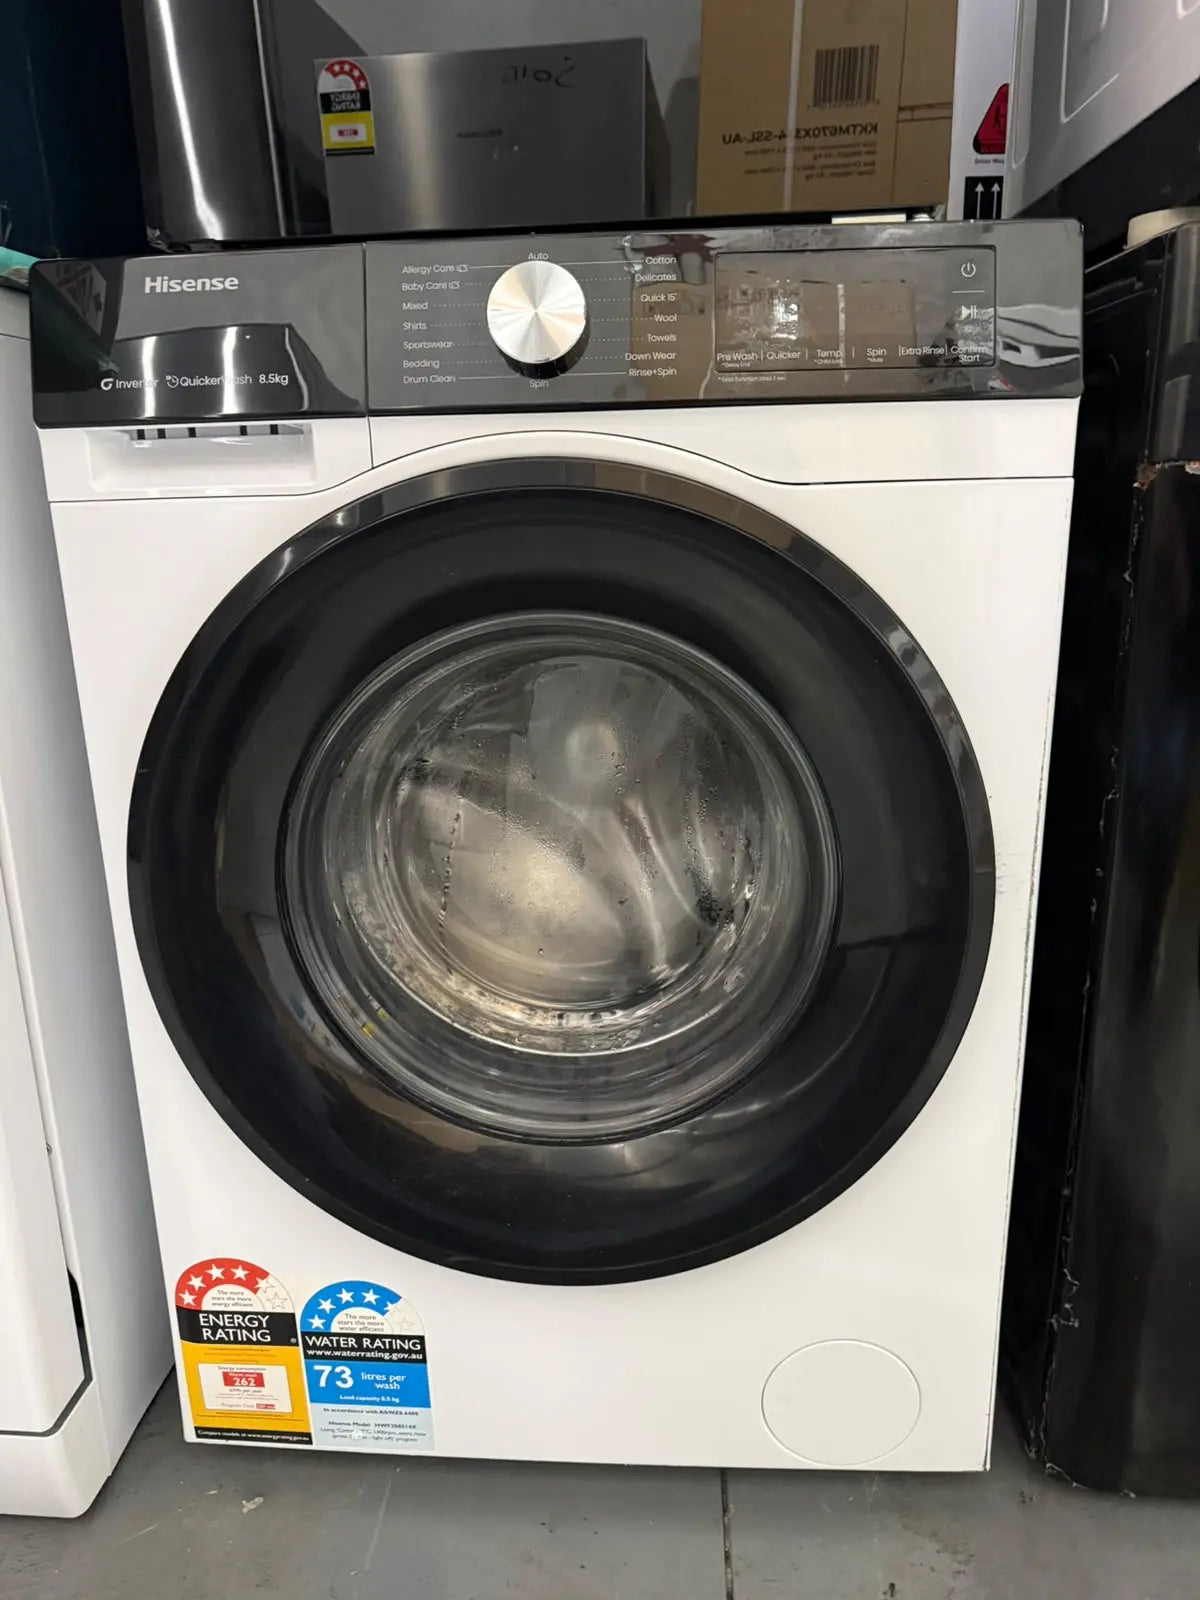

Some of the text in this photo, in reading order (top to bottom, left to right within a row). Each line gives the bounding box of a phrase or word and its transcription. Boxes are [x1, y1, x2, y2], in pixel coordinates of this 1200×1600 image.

[528, 252, 549, 260] Auto
[645, 256, 676, 264] Cotton
[402, 264, 455, 276] Allergy Care
[634, 274, 676, 282] Delicates
[144, 276, 239, 294] Hisense
[402, 282, 448, 292] Baby Care
[640, 293, 666, 302] Quick
[402, 302, 428, 310] Mixed
[654, 314, 677, 322] Wool
[402, 322, 428, 330] Shirts
[647, 333, 678, 342] Towels
[403, 341, 452, 350] Sportswear
[950, 345, 988, 354] Confirm
[866, 347, 887, 358] Spin
[901, 346, 945, 355] Extra Rinse
[624, 352, 676, 360] Down Wear
[716, 351, 758, 361] Pre Wash
[766, 351, 801, 360] Quicker
[958, 354, 980, 362] Start
[403, 360, 440, 369] Bedding
[628, 367, 677, 378] Rinse+Spin
[258, 372, 290, 386] 8.5kg
[402, 374, 456, 384] Drum Clean
[529, 380, 550, 390] Spin
[199, 1313, 270, 1328] ENERGY
[202, 1328, 271, 1342] RATING
[305, 1336, 421, 1350] WATER RATING
[306, 1349, 423, 1360] www.waterrating.gov.au
[313, 1364, 406, 1388] 73 litres per
[233, 1378, 256, 1386] 262
[374, 1382, 400, 1390] wash
